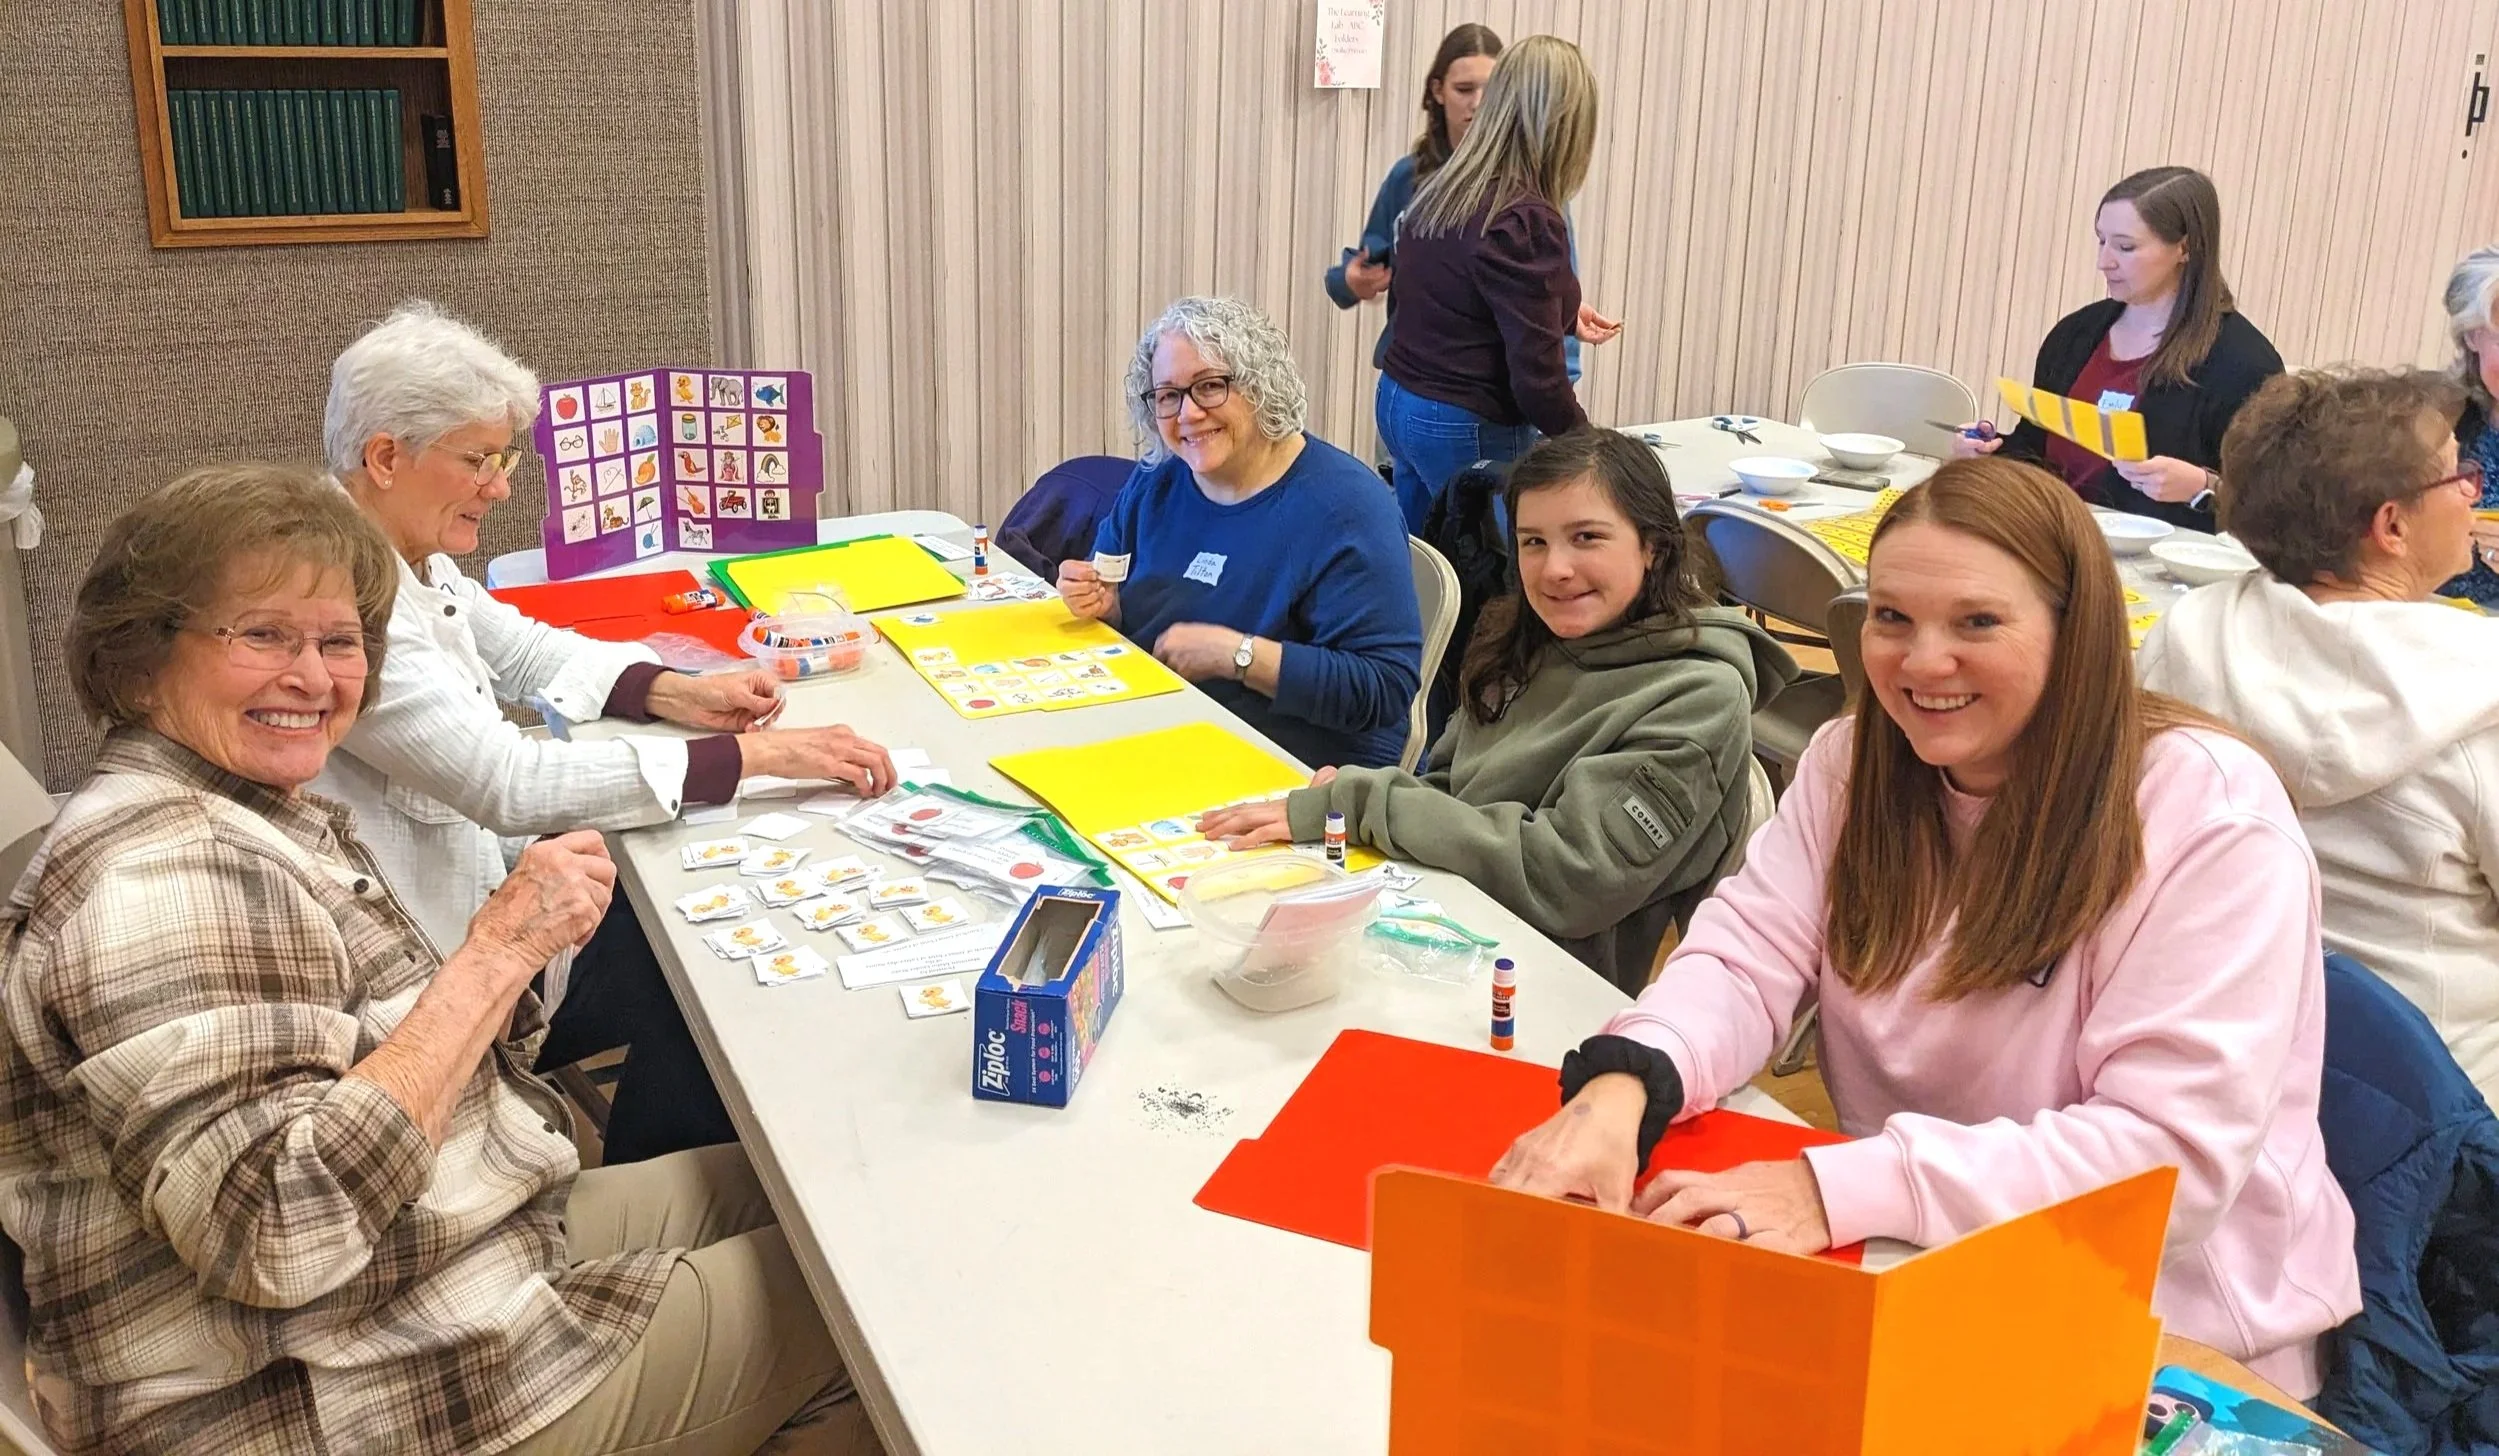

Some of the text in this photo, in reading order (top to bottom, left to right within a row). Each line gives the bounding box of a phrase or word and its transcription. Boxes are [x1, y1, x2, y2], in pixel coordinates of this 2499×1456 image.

[1631, 805, 1663, 840] COMFRT
[1059, 888, 1095, 899] Ziploc
[1010, 999, 1028, 1034] Snack
[981, 1029, 1010, 1090] Ziploc
